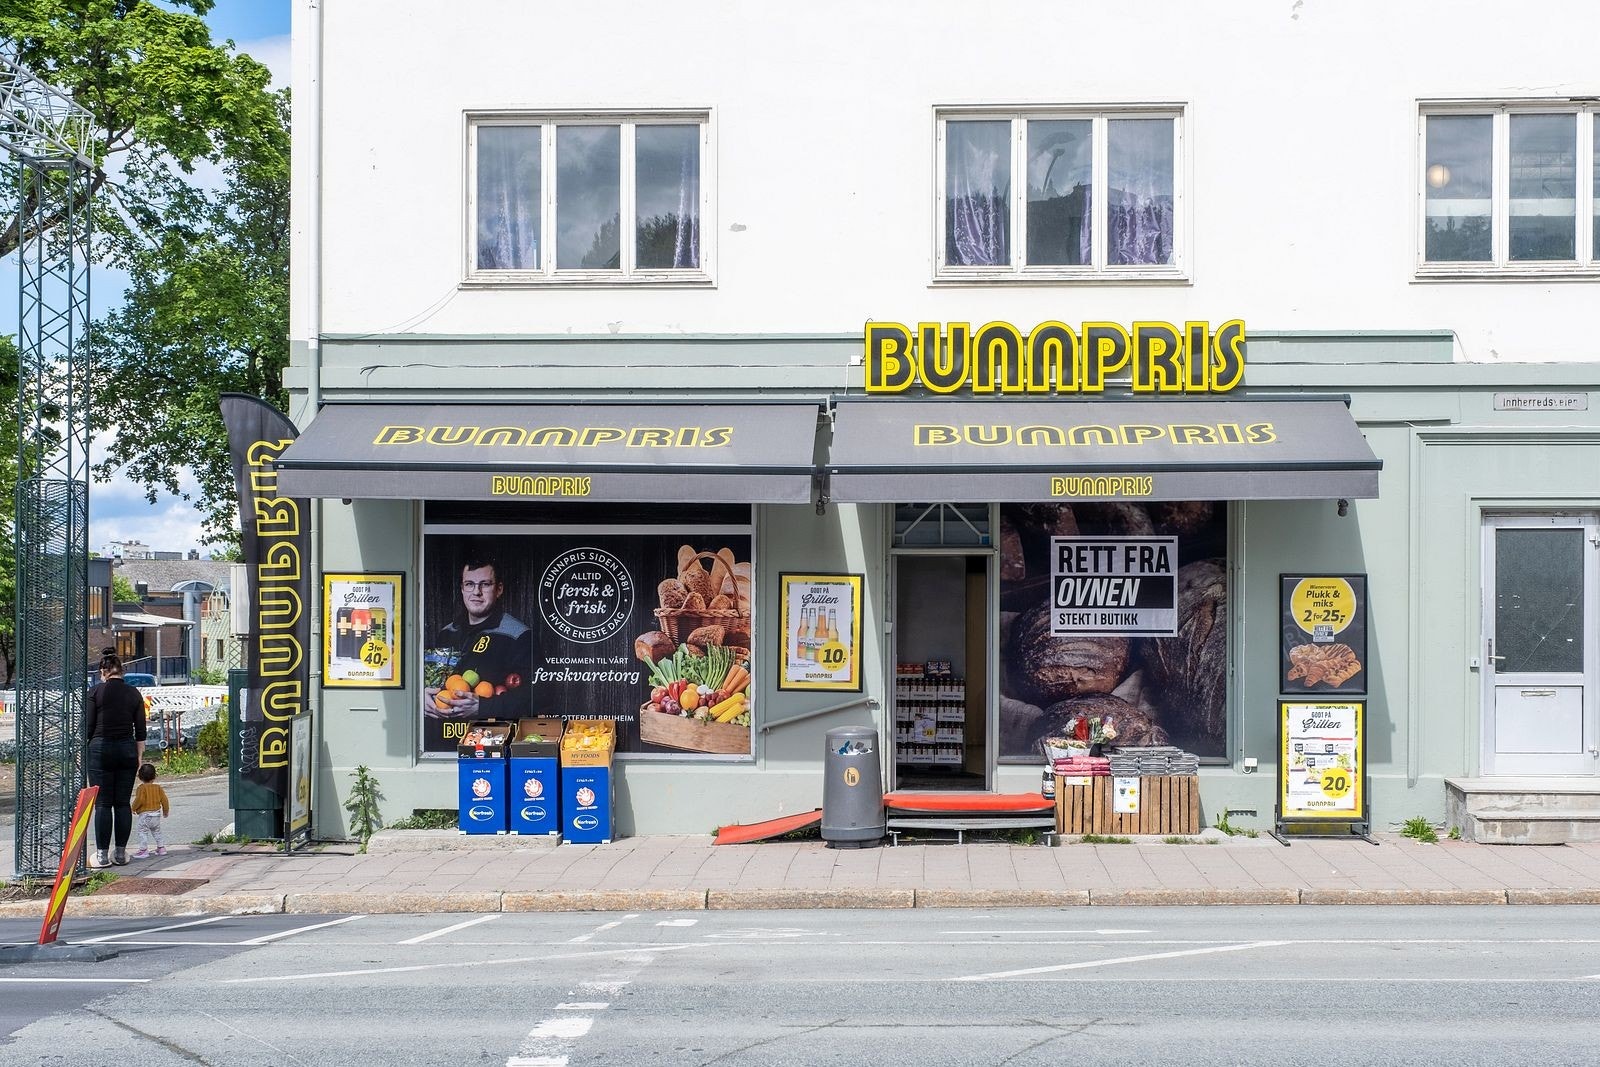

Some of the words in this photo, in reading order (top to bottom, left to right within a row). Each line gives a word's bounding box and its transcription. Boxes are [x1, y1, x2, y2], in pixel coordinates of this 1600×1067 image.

[865, 319, 1245, 393] BUNNPRIS
[372, 425, 734, 448] BUNNPRIS
[913, 422, 1278, 446] BUNNPRIS
[492, 475, 591, 496] BUNNPRIS
[1051, 476, 1153, 496] BUNNPRIS
[1058, 545, 1117, 573] RETT
[1124, 545, 1171, 573] FRA
[544, 551, 586, 588] BUNNPRIS
[588, 552, 618, 572] SIDEN
[616, 571, 630, 591] 1981
[571, 572, 602, 580] ALLTID
[557, 583, 599, 600] fersk
[601, 584, 615, 597] &
[1057, 578, 1141, 607] OVNEN
[1306, 590, 1331, 598] Plukk
[1332, 590, 1340, 598] &
[565, 600, 607, 616] frisk
[801, 594, 839, 607] Grillen
[1313, 599, 1334, 607] miks
[1059, 613, 1092, 625] STEKT
[1094, 613, 1097, 625] I
[1100, 613, 1138, 625] BUTIKK
[1303, 609, 1312, 622] 2
[548, 612, 571, 635] HVER
[572, 626, 608, 639] ENESTE
[607, 611, 625, 630] DAG
[368, 642, 375, 651] 3
[608, 656, 629, 664] VÅRT
[532, 667, 640, 685] ferskvaretorg
[1302, 718, 1341, 732] Grillen
